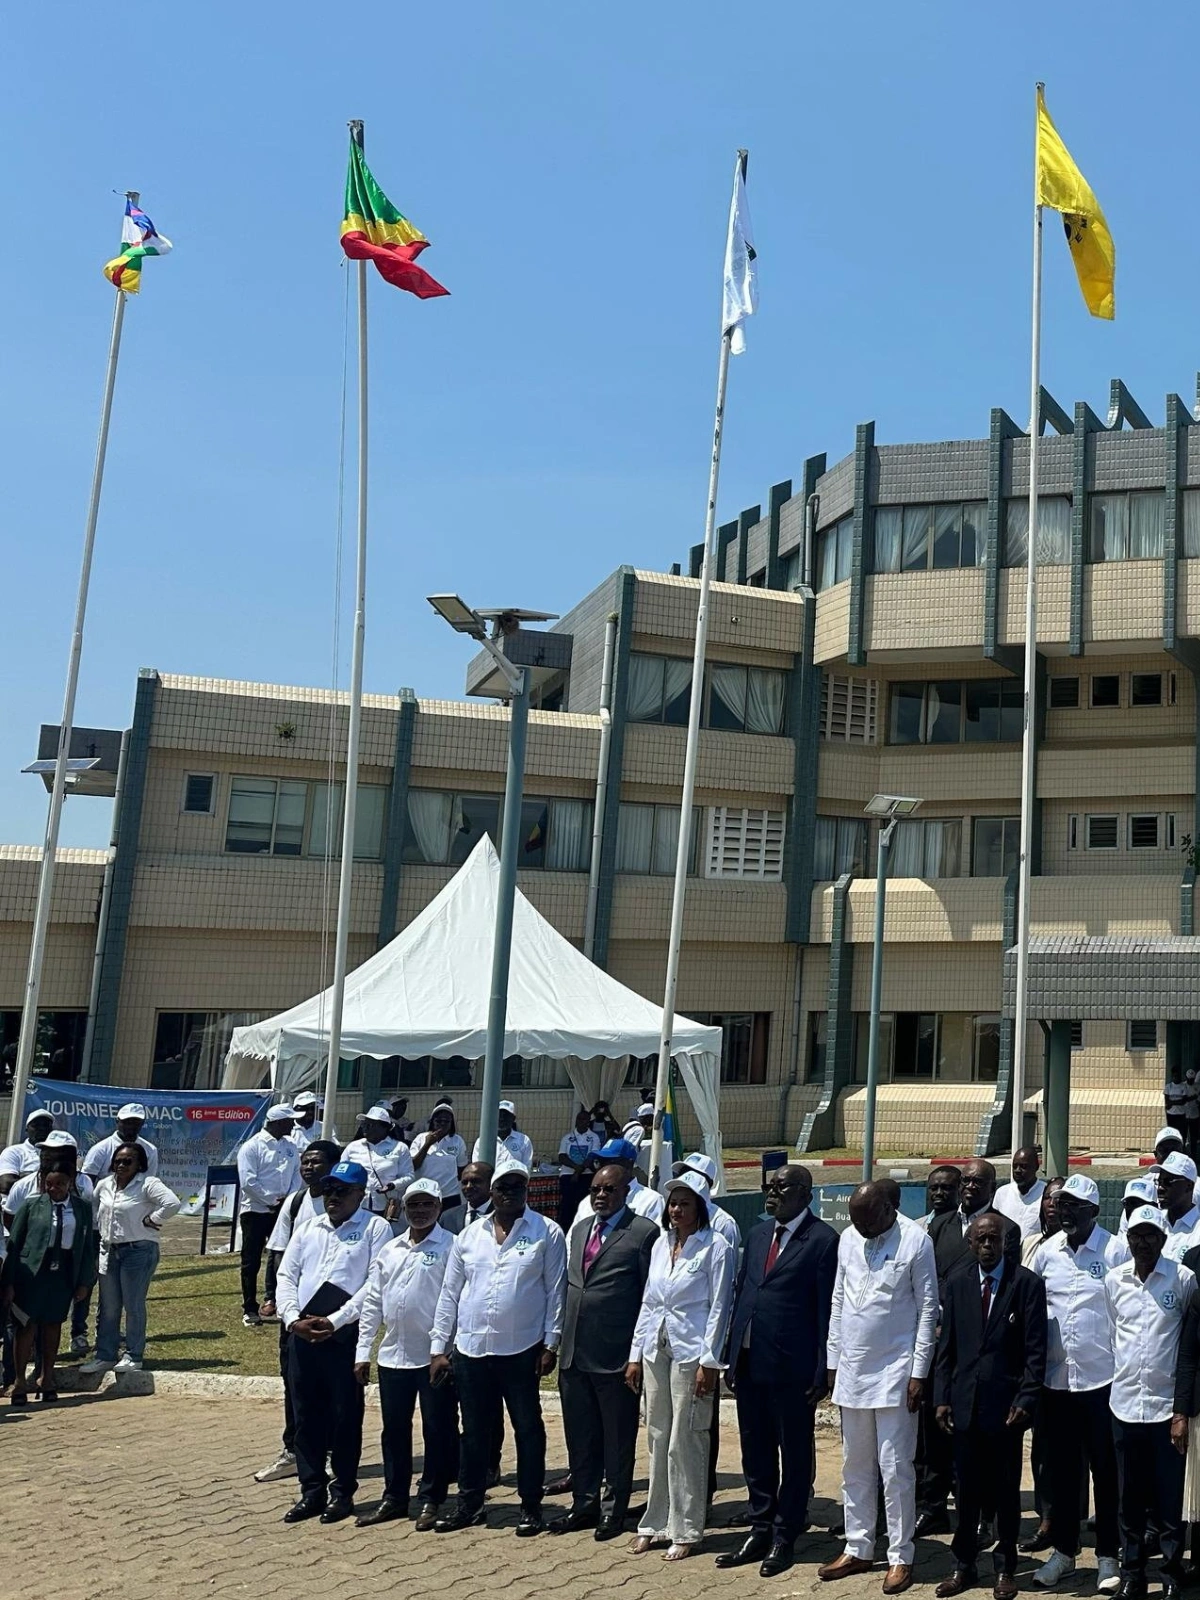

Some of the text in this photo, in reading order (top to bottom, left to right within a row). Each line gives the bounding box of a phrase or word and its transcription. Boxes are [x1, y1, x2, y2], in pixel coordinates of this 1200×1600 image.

[145, 1106, 183, 1120] MAC
[191, 1110, 203, 1119] 16
[218, 1109, 251, 1119] Edition
